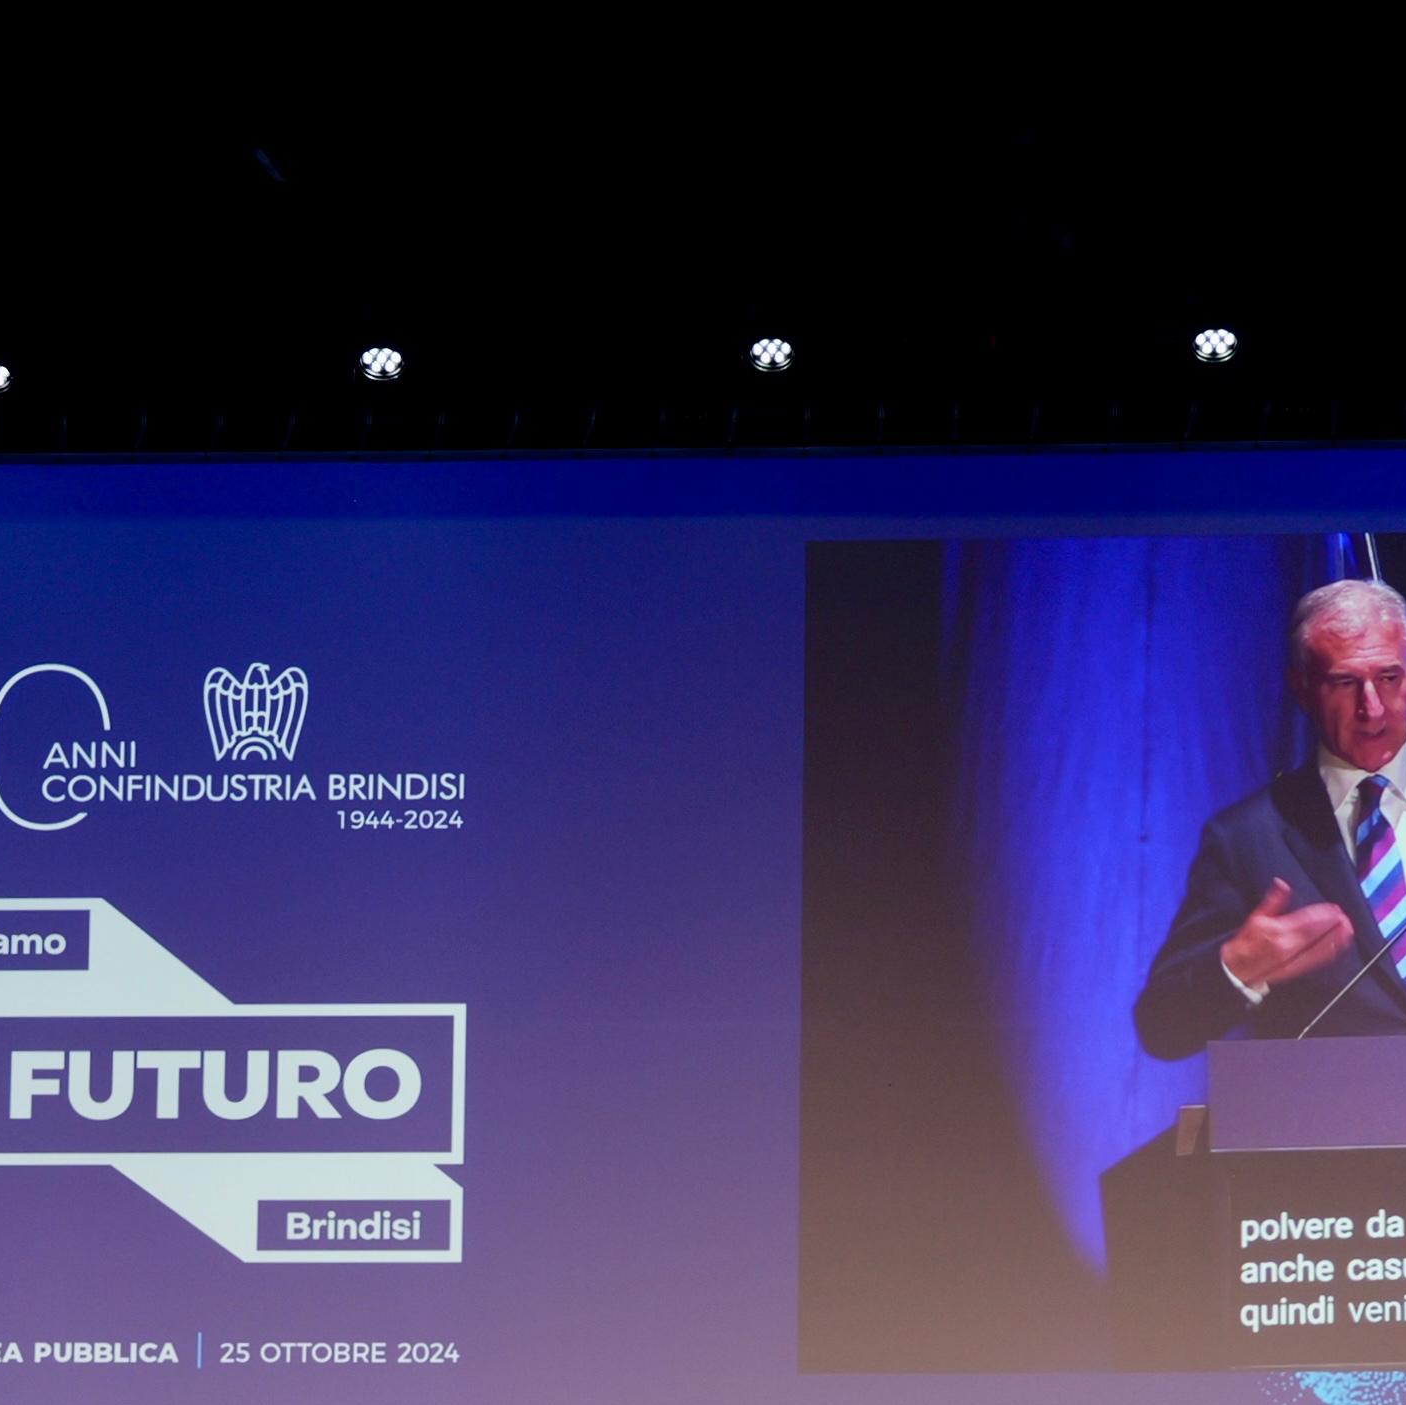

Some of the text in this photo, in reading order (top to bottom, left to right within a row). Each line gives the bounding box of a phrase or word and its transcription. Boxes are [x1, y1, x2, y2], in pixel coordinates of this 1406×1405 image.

[43, 740, 136, 769] ANNI
[41, 773, 465, 802] CONFINDUSTRIA BRINDISI
[336, 810, 464, 830] 1944-2024
[9, 1048, 422, 1121] FUTURO
[286, 1211, 421, 1241] Brindisi
[1240, 1213, 1353, 1248] polvere
[1366, 1210, 1405, 1238] da
[1240, 1254, 1334, 1284] anche
[1240, 1296, 1335, 1332] quindi
[34, 1342, 179, 1364] PUBBLICA
[219, 1342, 460, 1365] 25 OTTOBRE 2024
